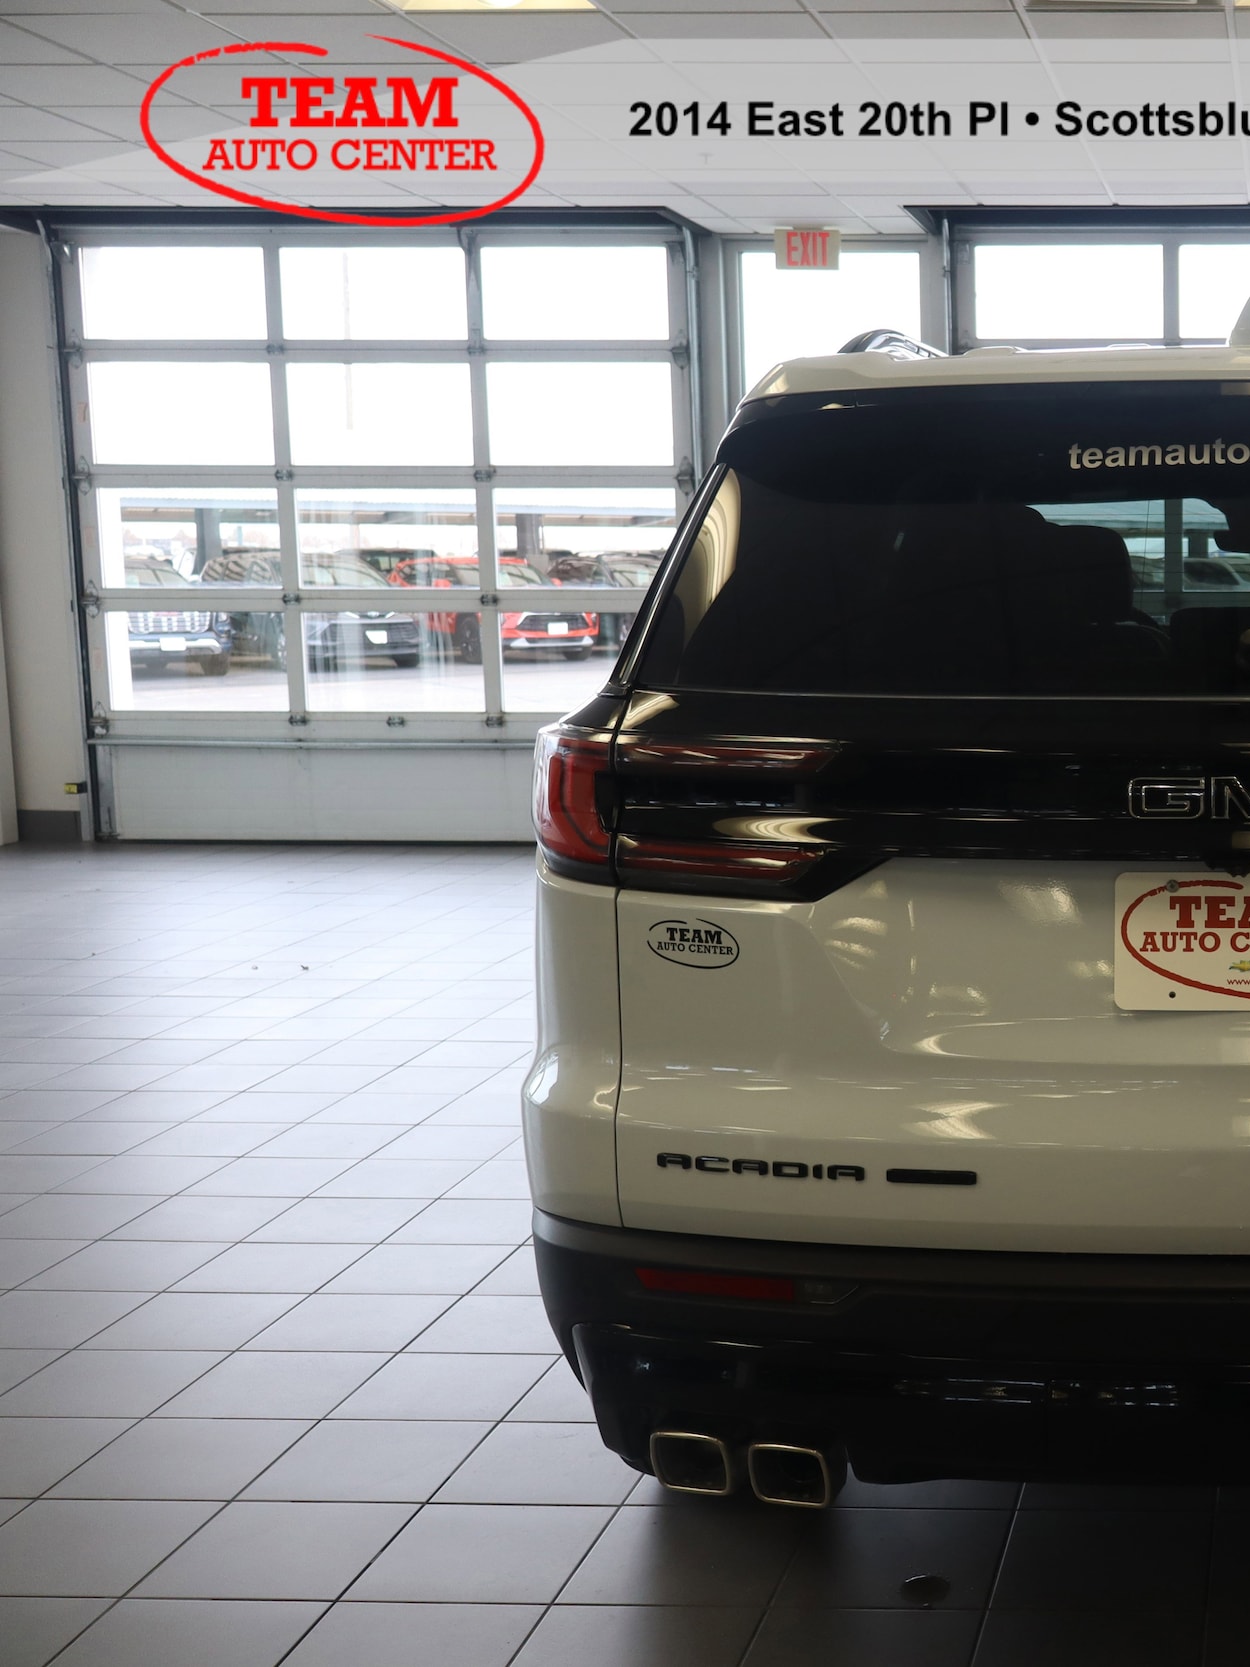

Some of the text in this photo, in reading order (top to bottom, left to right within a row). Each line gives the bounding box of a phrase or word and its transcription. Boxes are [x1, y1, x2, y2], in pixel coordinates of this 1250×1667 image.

[786, 231, 830, 267] EXIT
[666, 927, 723, 945] TEAM
[1139, 932, 1222, 953] AUTO
[656, 941, 734, 956] AUTO CENTER
[657, 1152, 865, 1182] ACADIA
